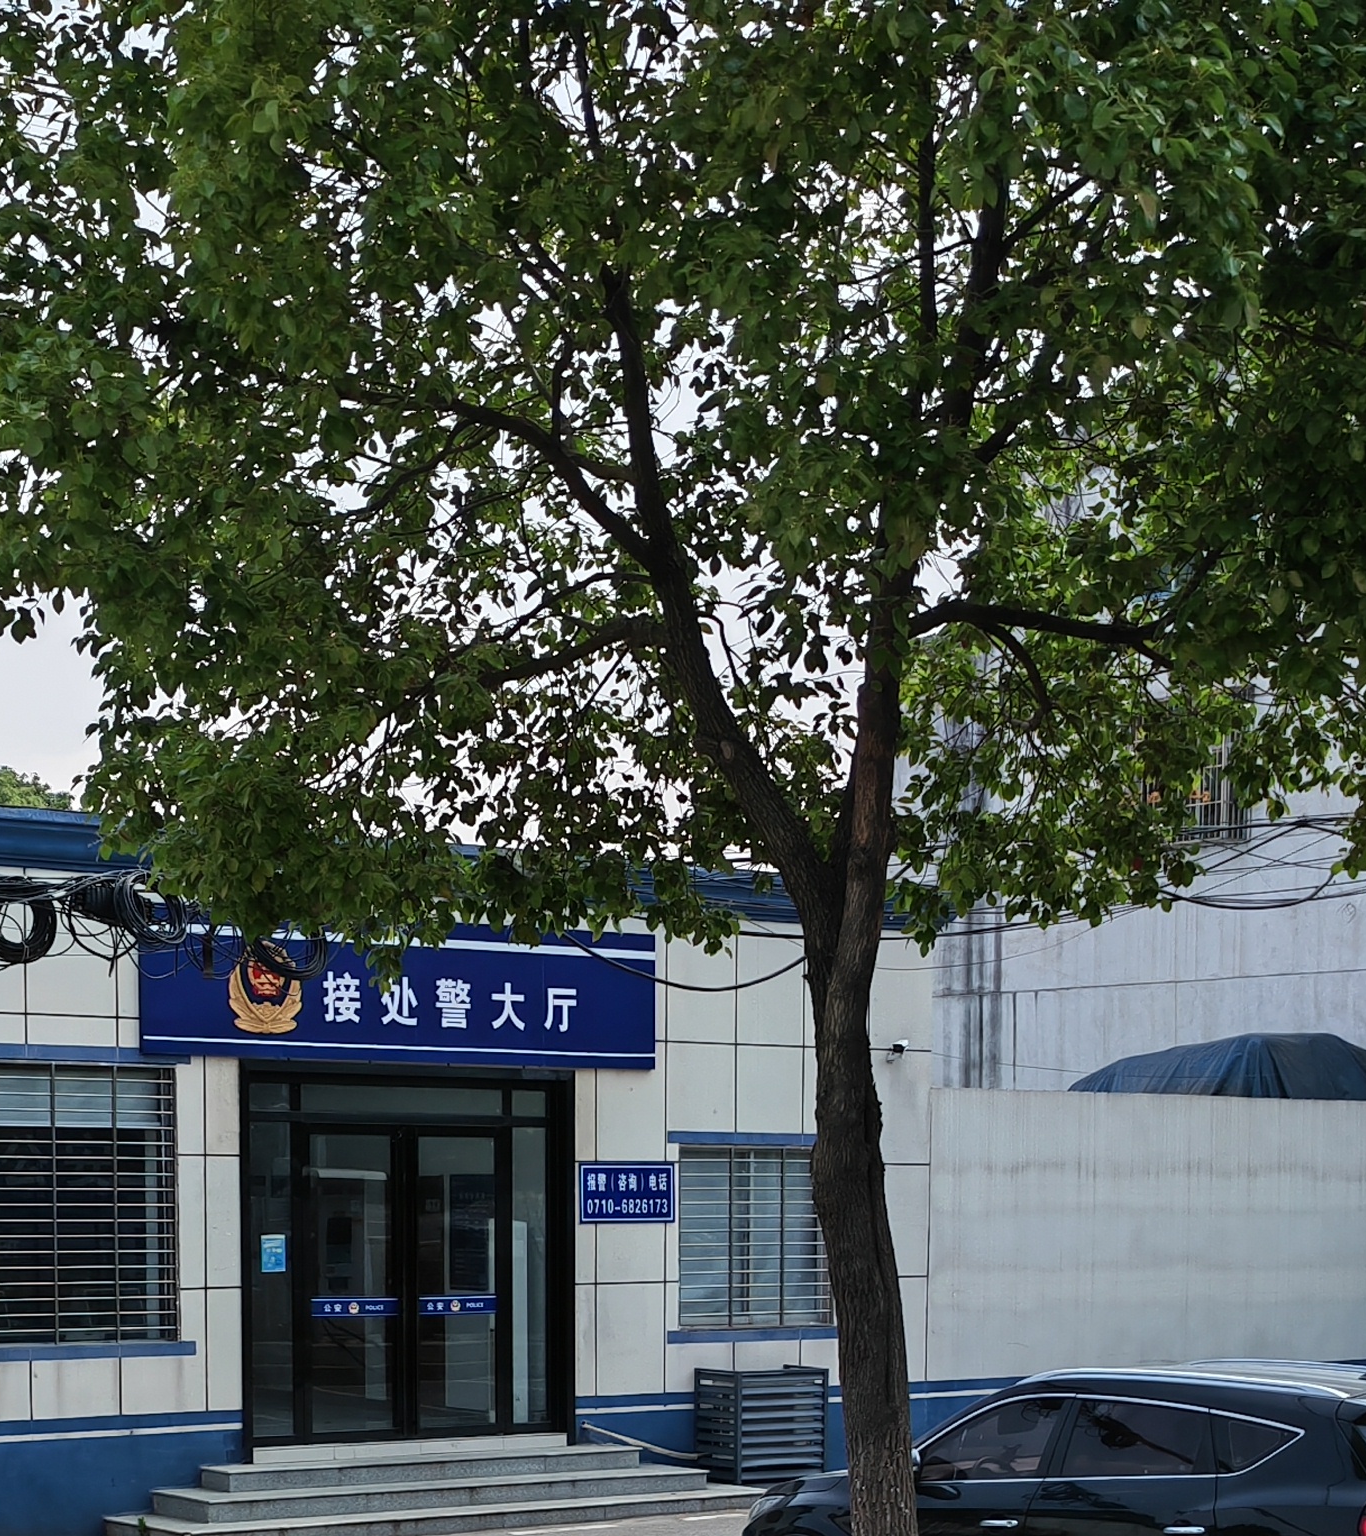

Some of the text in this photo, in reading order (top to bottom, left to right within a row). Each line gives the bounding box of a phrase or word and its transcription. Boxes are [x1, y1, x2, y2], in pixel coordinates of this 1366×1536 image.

[323, 972, 578, 1033] 接处警大厅
[587, 1199, 668, 1214] 0710-6826173
[323, 1303, 342, 1313] 公安
[427, 1301, 484, 1311] 公安 POLICE
